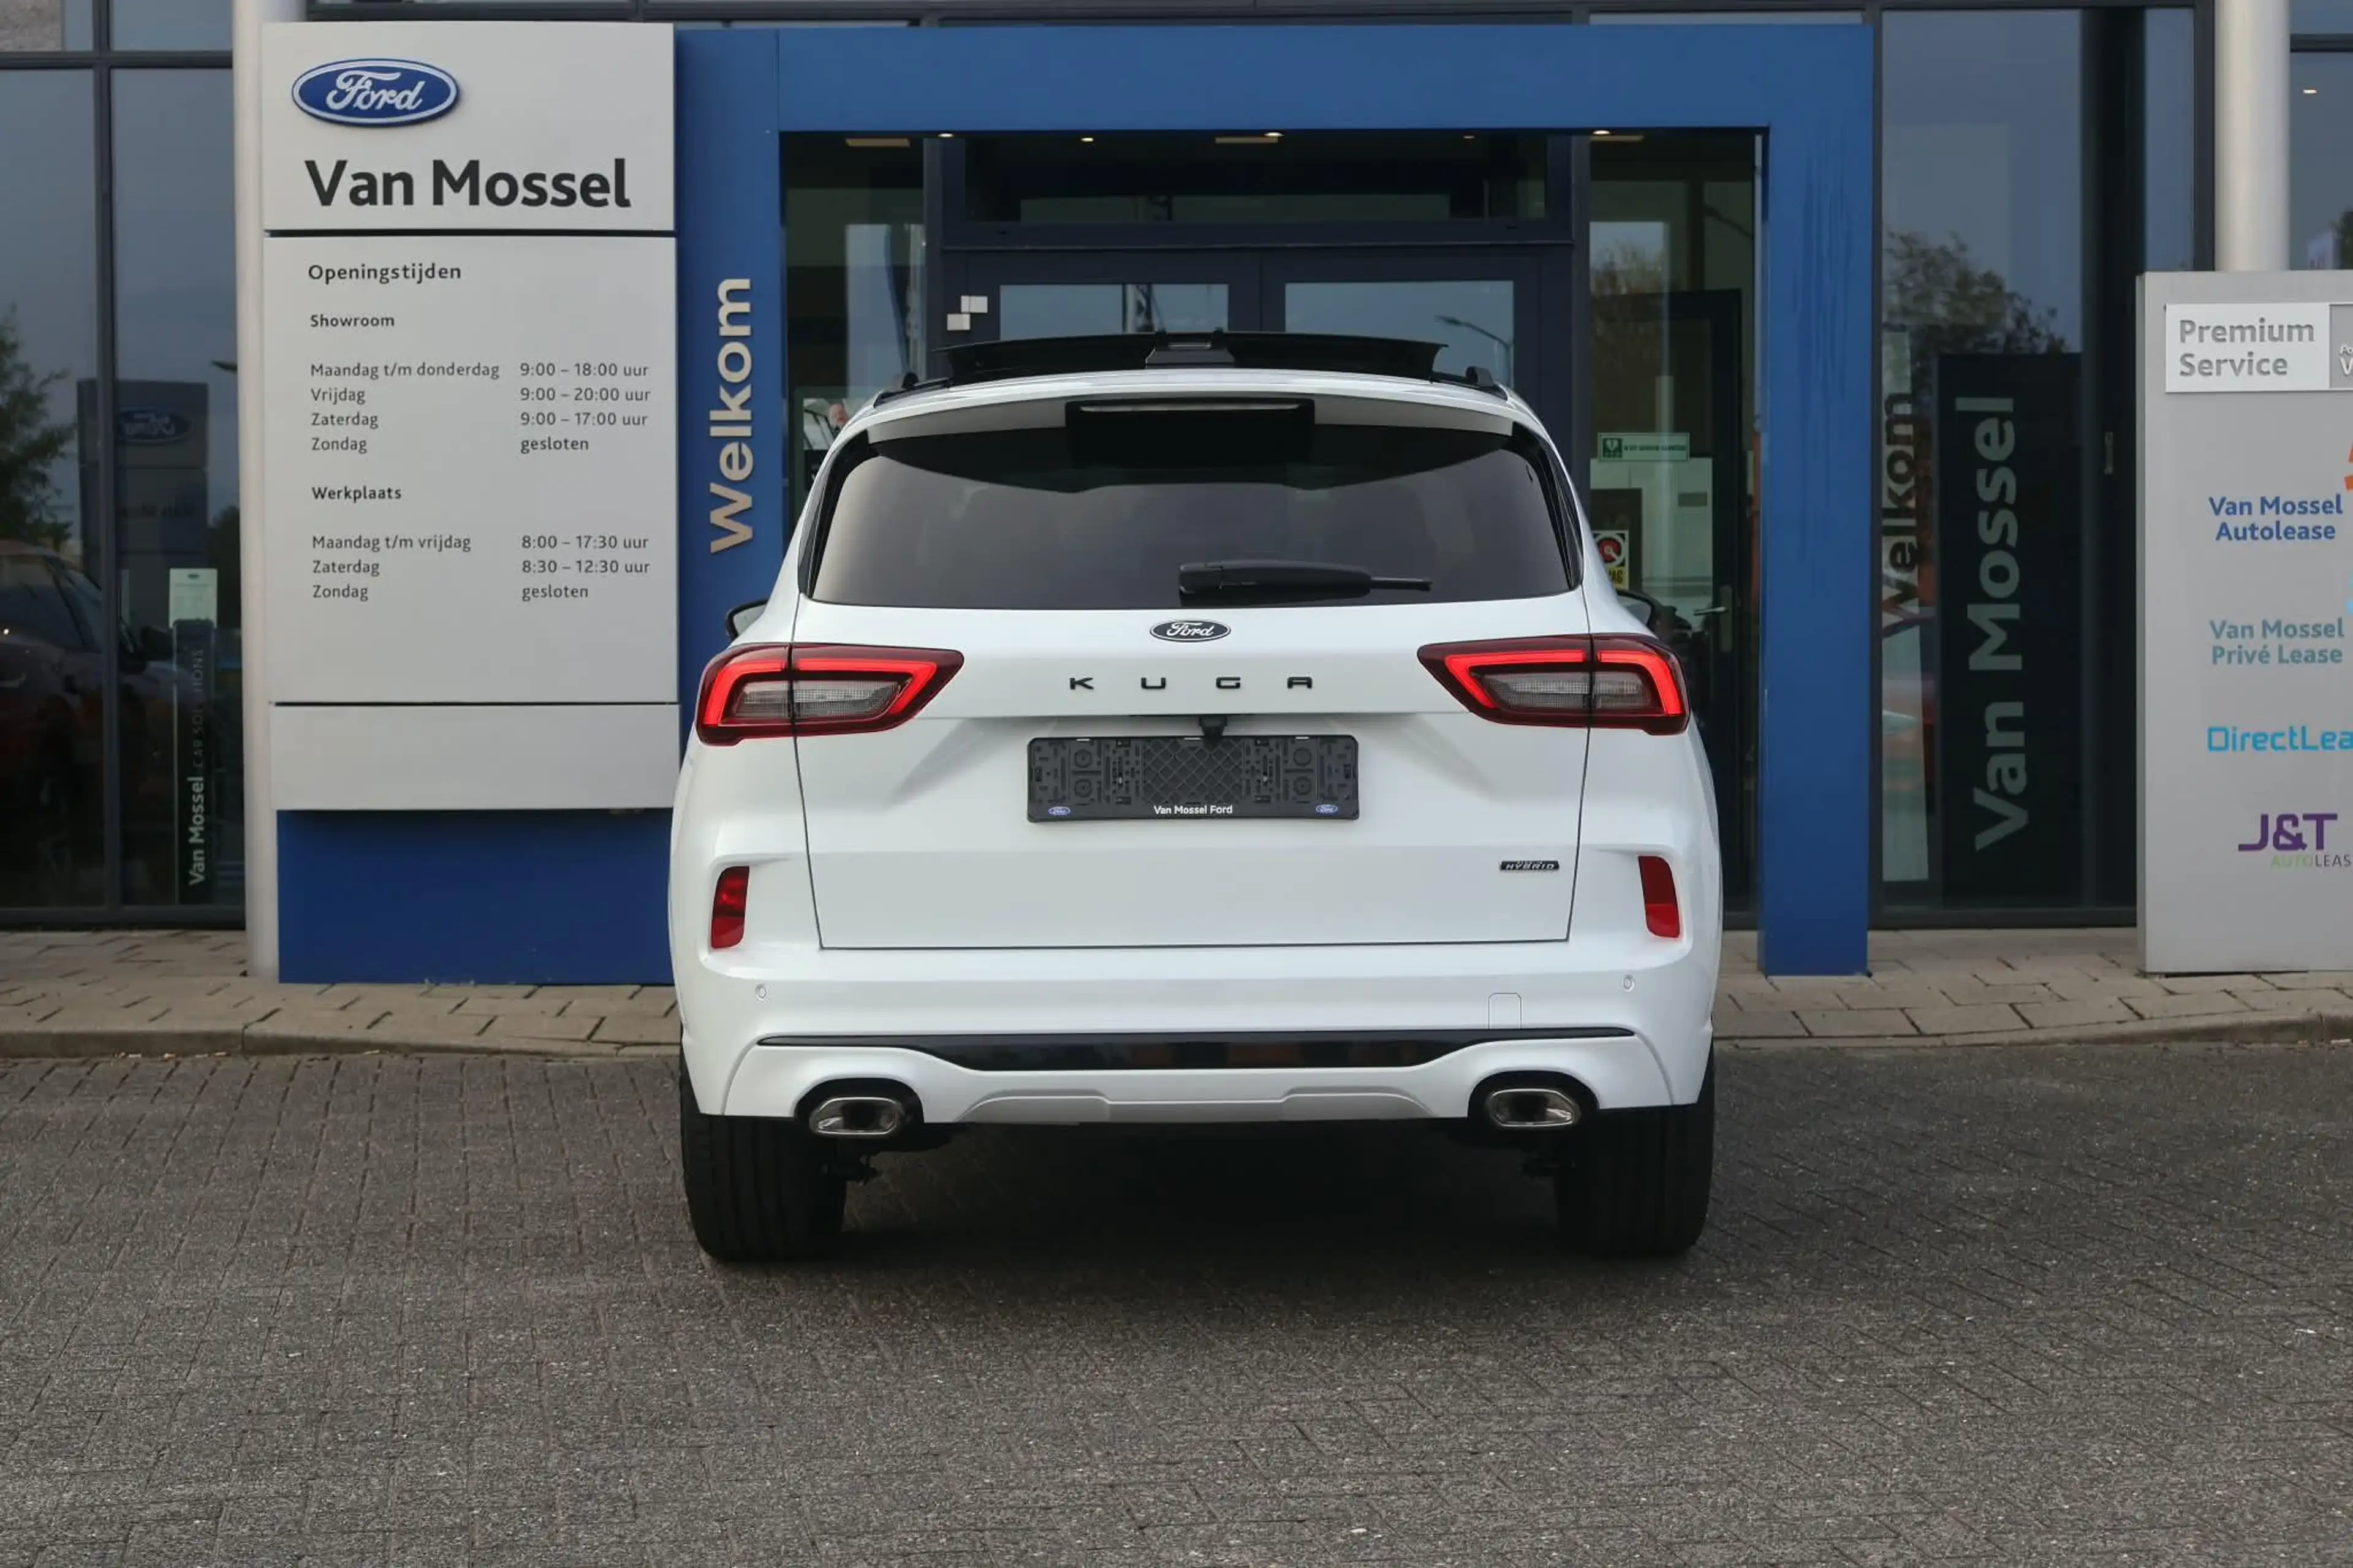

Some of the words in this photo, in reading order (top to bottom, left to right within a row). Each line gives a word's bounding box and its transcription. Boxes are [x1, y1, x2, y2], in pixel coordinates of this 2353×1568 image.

[325, 70, 425, 110] Ford
[304, 159, 414, 206] Van
[431, 157, 632, 208] Mossel
[308, 262, 461, 286] Openingstijden
[310, 313, 395, 328] Showroom
[2179, 317, 2315, 344] Premium
[311, 362, 379, 381] Maandag
[384, 362, 412, 377] t/m
[416, 362, 500, 380] donderdag
[520, 362, 556, 376] 9:00
[574, 362, 618, 377] 18:00
[623, 366, 649, 377] uur
[2179, 350, 2288, 377] Service
[310, 387, 366, 406] Vrijdag
[520, 387, 556, 401] 9:00
[574, 387, 620, 401] 20:00
[625, 391, 651, 401] uur
[311, 411, 379, 430] Zaterdag
[520, 412, 556, 426] 9:00
[574, 412, 616, 426] 17:00
[622, 415, 648, 426] uur
[710, 278, 753, 553] Welkom
[312, 436, 368, 455] Zondag
[520, 436, 589, 455] gesloten
[311, 485, 402, 504] Werkplaats
[2207, 496, 2253, 516] Van
[2259, 493, 2344, 515] Mossel
[1955, 396, 2023, 671] Mossel
[2215, 520, 2336, 542] Autolease
[313, 534, 381, 553] Maandag
[385, 534, 414, 549] t/m
[418, 534, 471, 553] vrijdag
[521, 535, 558, 549] 8:00
[575, 535, 618, 549] 17:30
[623, 538, 649, 549] uur
[313, 559, 380, 577] Zaterdag
[521, 559, 558, 574] 8:30
[575, 559, 619, 574] 12:30
[624, 563, 650, 574] uur
[313, 583, 368, 602] Zondag
[521, 583, 588, 602] gesloten
[1165, 622, 1214, 637] Ford
[2208, 619, 2255, 640] Van
[2261, 616, 2345, 640] Mossel
[2211, 643, 2271, 665] Privé
[2277, 643, 2344, 665] Lease
[1069, 676, 1313, 691] KUGA
[1972, 701, 2028, 851] Van
[186, 776, 205, 844] Mossel
[1153, 805, 1172, 815] Van
[1173, 803, 1207, 815] Mossel
[1210, 804, 1233, 815] Ford
[2238, 812, 2338, 852] J&T
[188, 849, 205, 886] Van
